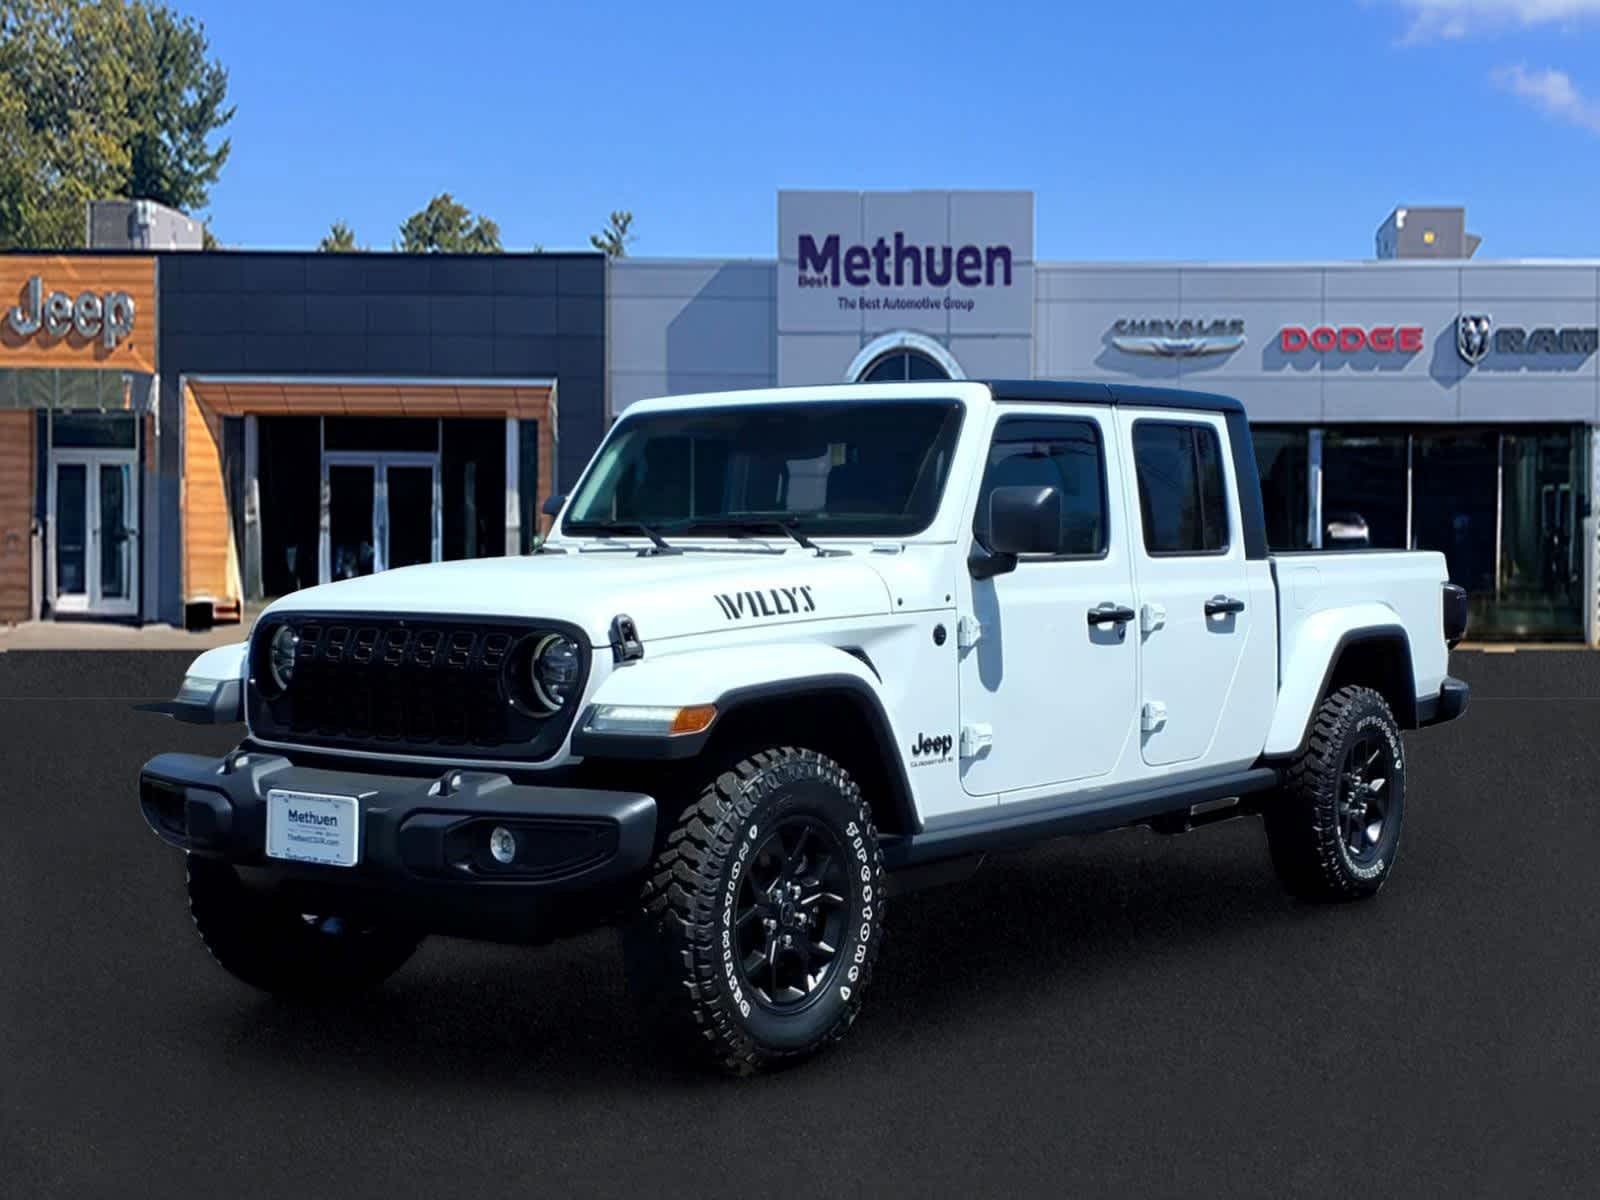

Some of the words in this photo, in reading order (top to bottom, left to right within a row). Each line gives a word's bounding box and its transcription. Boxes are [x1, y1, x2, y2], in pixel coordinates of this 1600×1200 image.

[798, 232, 1012, 287] Methuen
[9, 275, 135, 349] Jeep
[838, 297, 857, 310] The
[859, 297, 880, 310] Best
[883, 297, 940, 310] Automotive
[943, 297, 975, 312] Group
[1281, 327, 1424, 352] DODGE
[1495, 327, 1599, 353] RAM
[713, 585, 816, 620] WILLYS
[912, 732, 953, 758] Jeep
[288, 808, 338, 826] Methuen
